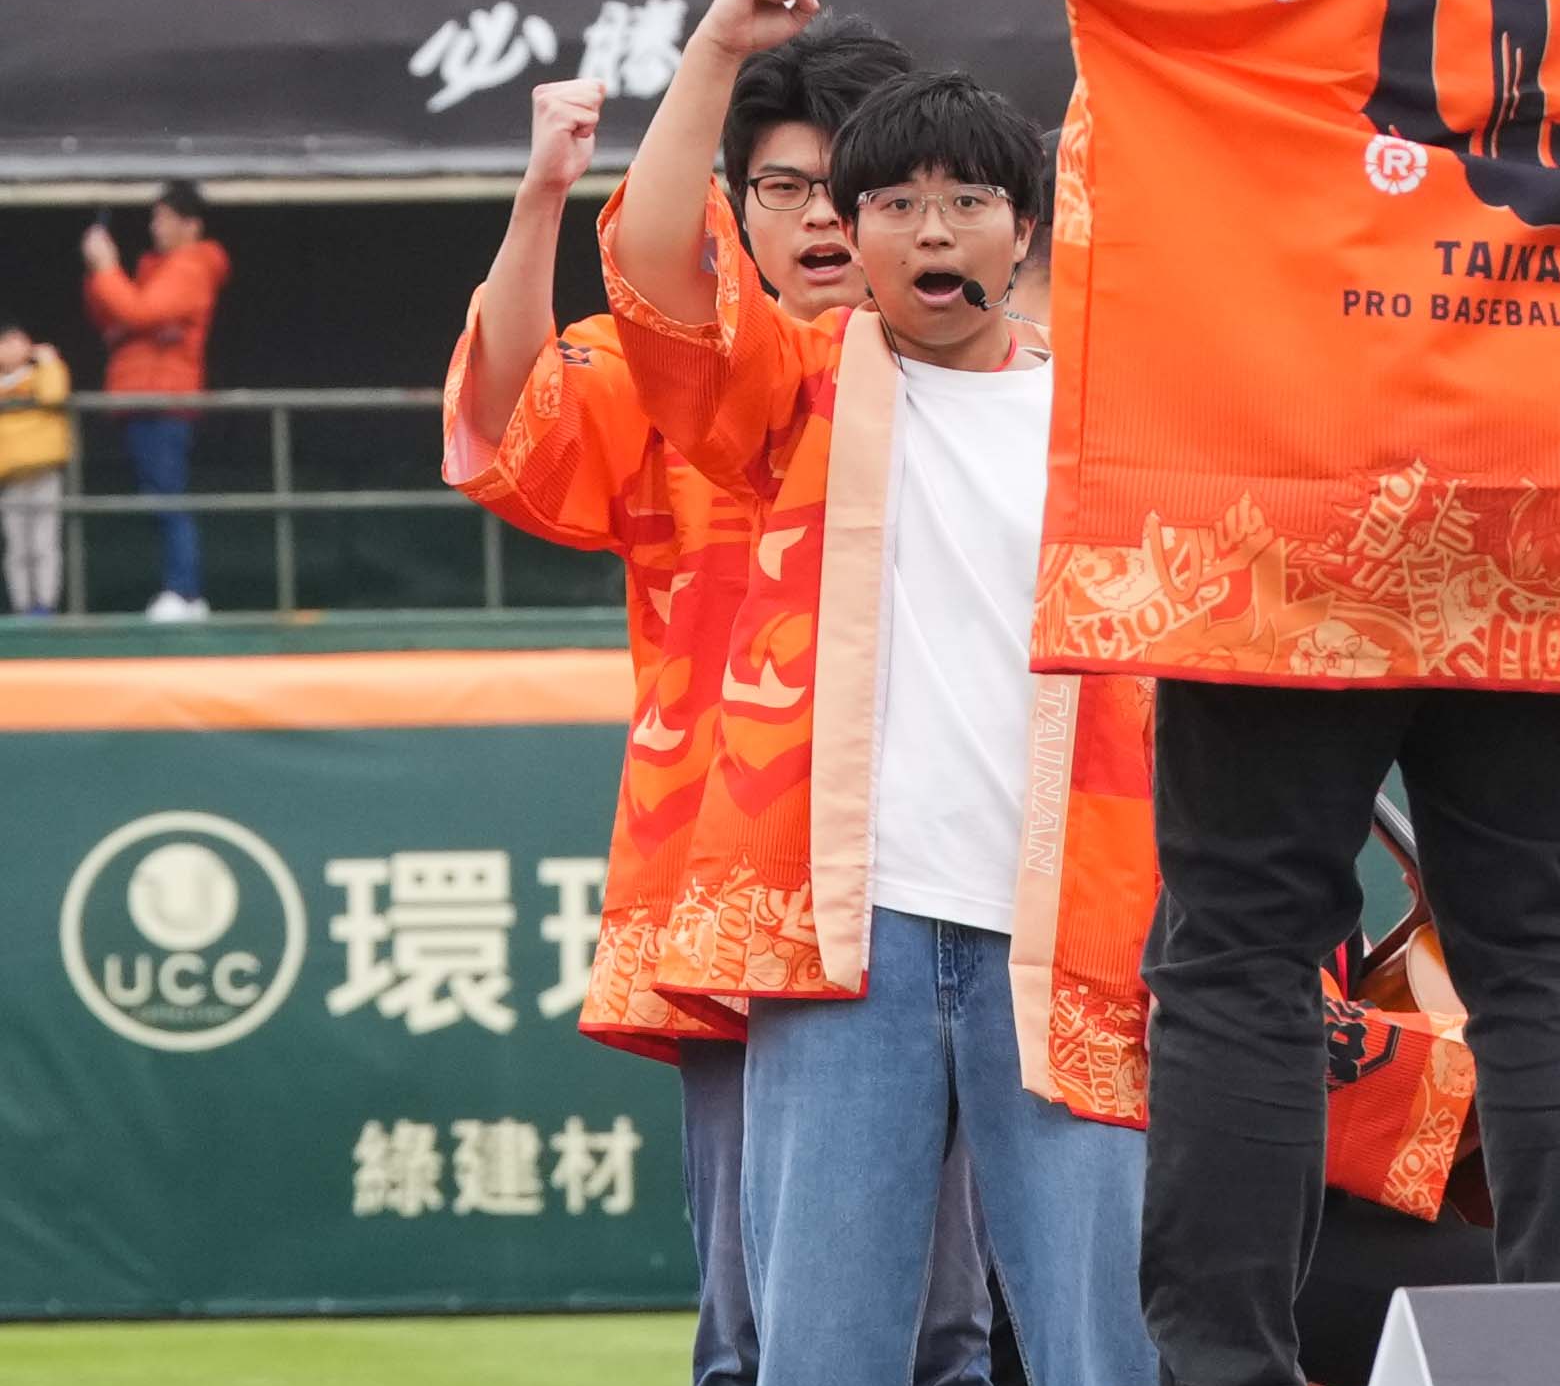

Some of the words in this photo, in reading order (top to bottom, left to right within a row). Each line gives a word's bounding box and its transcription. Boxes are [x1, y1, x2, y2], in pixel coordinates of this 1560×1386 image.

[1342, 289, 1412, 318] PRO
[1024, 683, 1071, 877] TAINAN
[103, 950, 263, 1009] UCC
[352, 1116, 644, 1215] 綠建材
